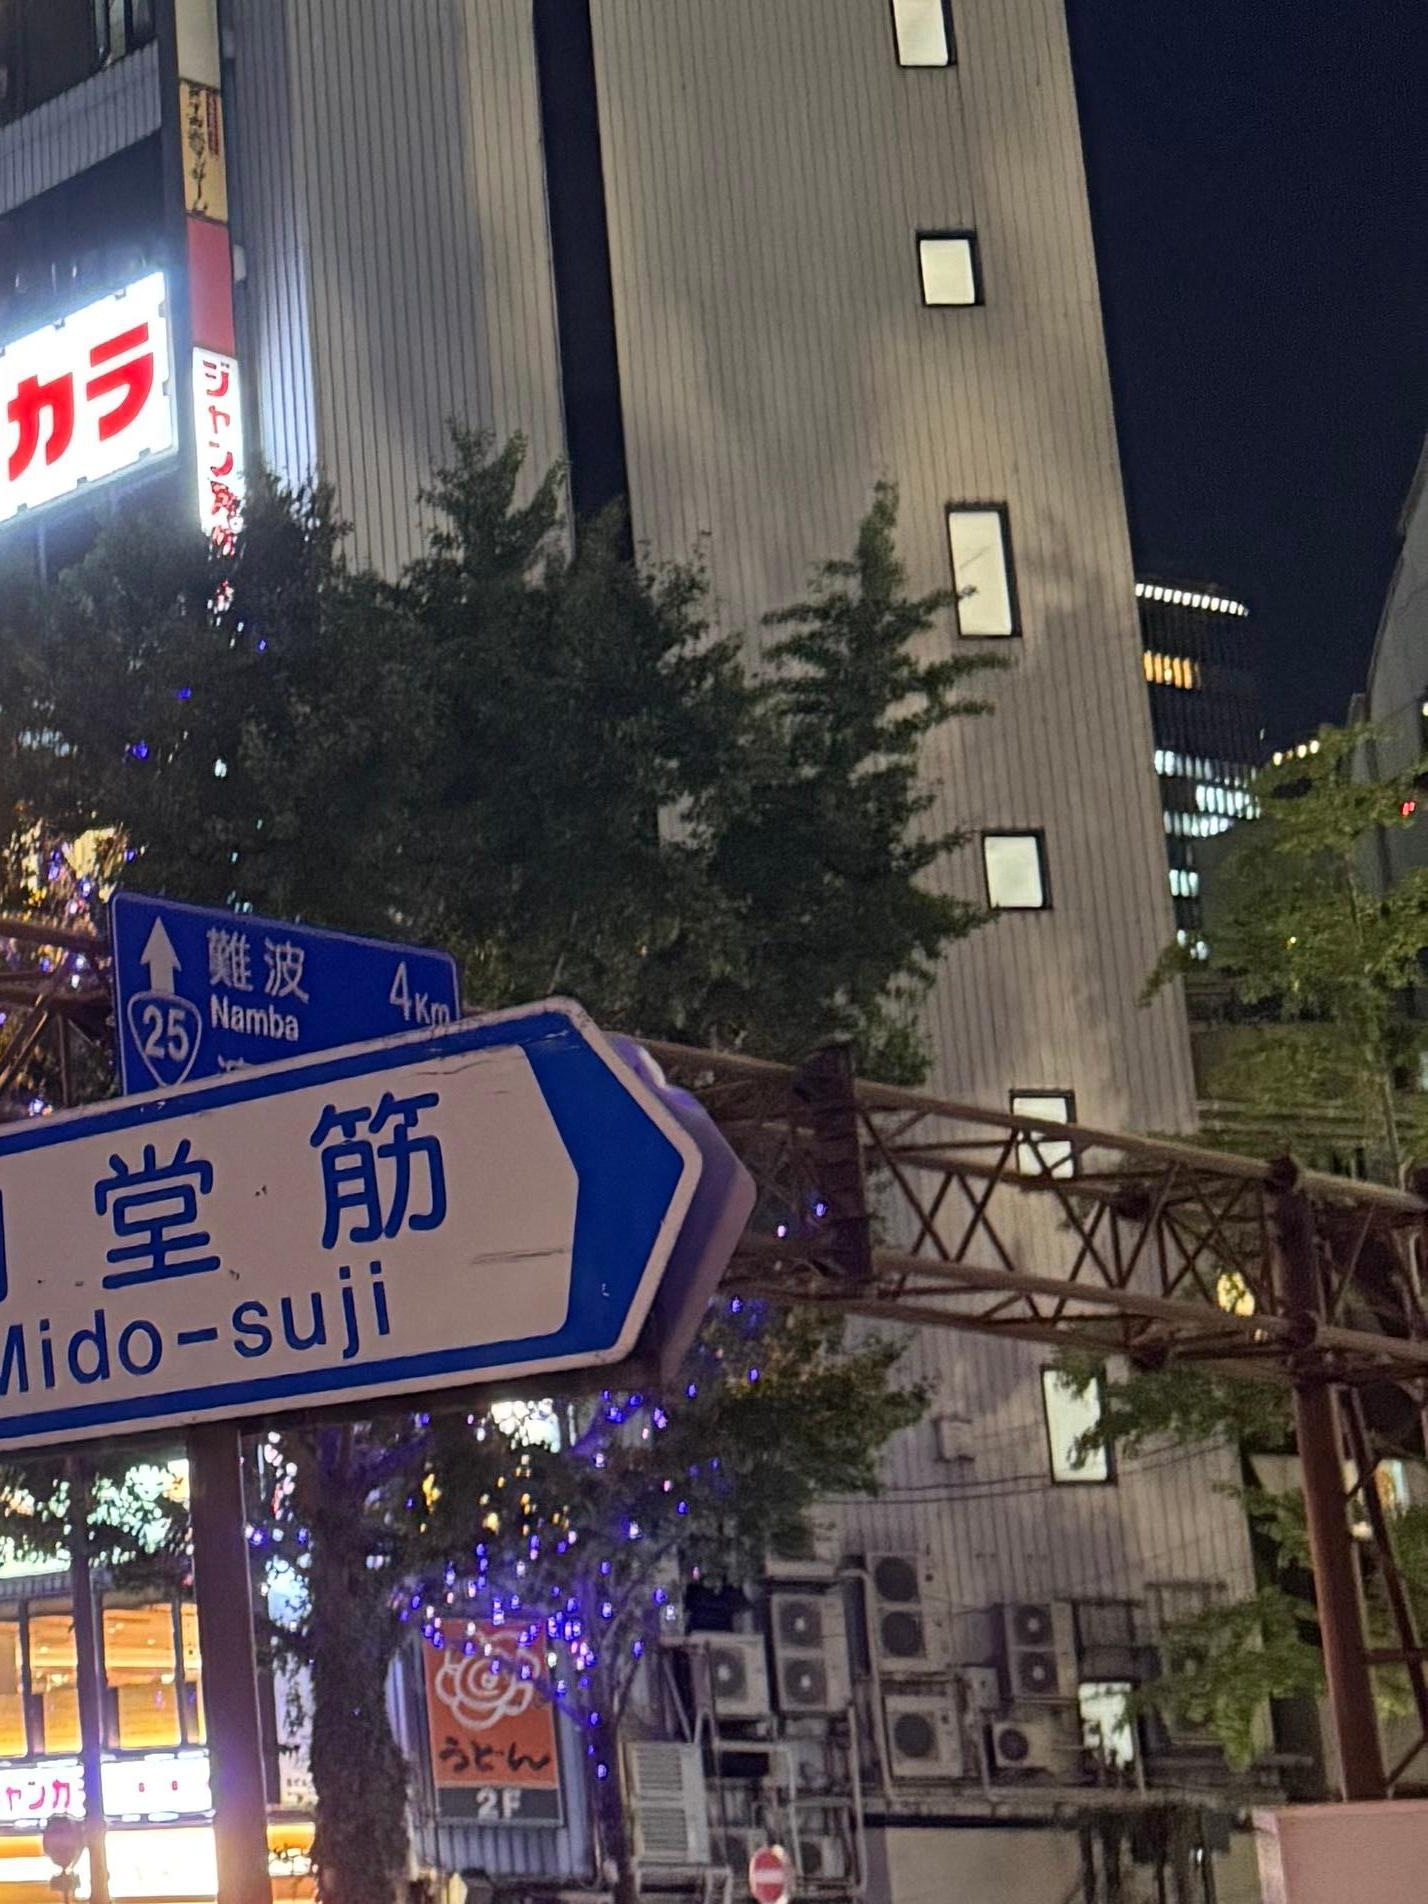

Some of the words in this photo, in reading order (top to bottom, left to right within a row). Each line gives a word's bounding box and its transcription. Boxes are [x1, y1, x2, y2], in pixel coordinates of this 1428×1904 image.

[202, 359, 240, 559] ジャン
[205, 926, 311, 1005] 難波
[142, 1004, 191, 1063] 25
[210, 993, 300, 1042] Namba
[438, 1736, 551, 1773] うどん
[475, 1787, 522, 1821] 2F
